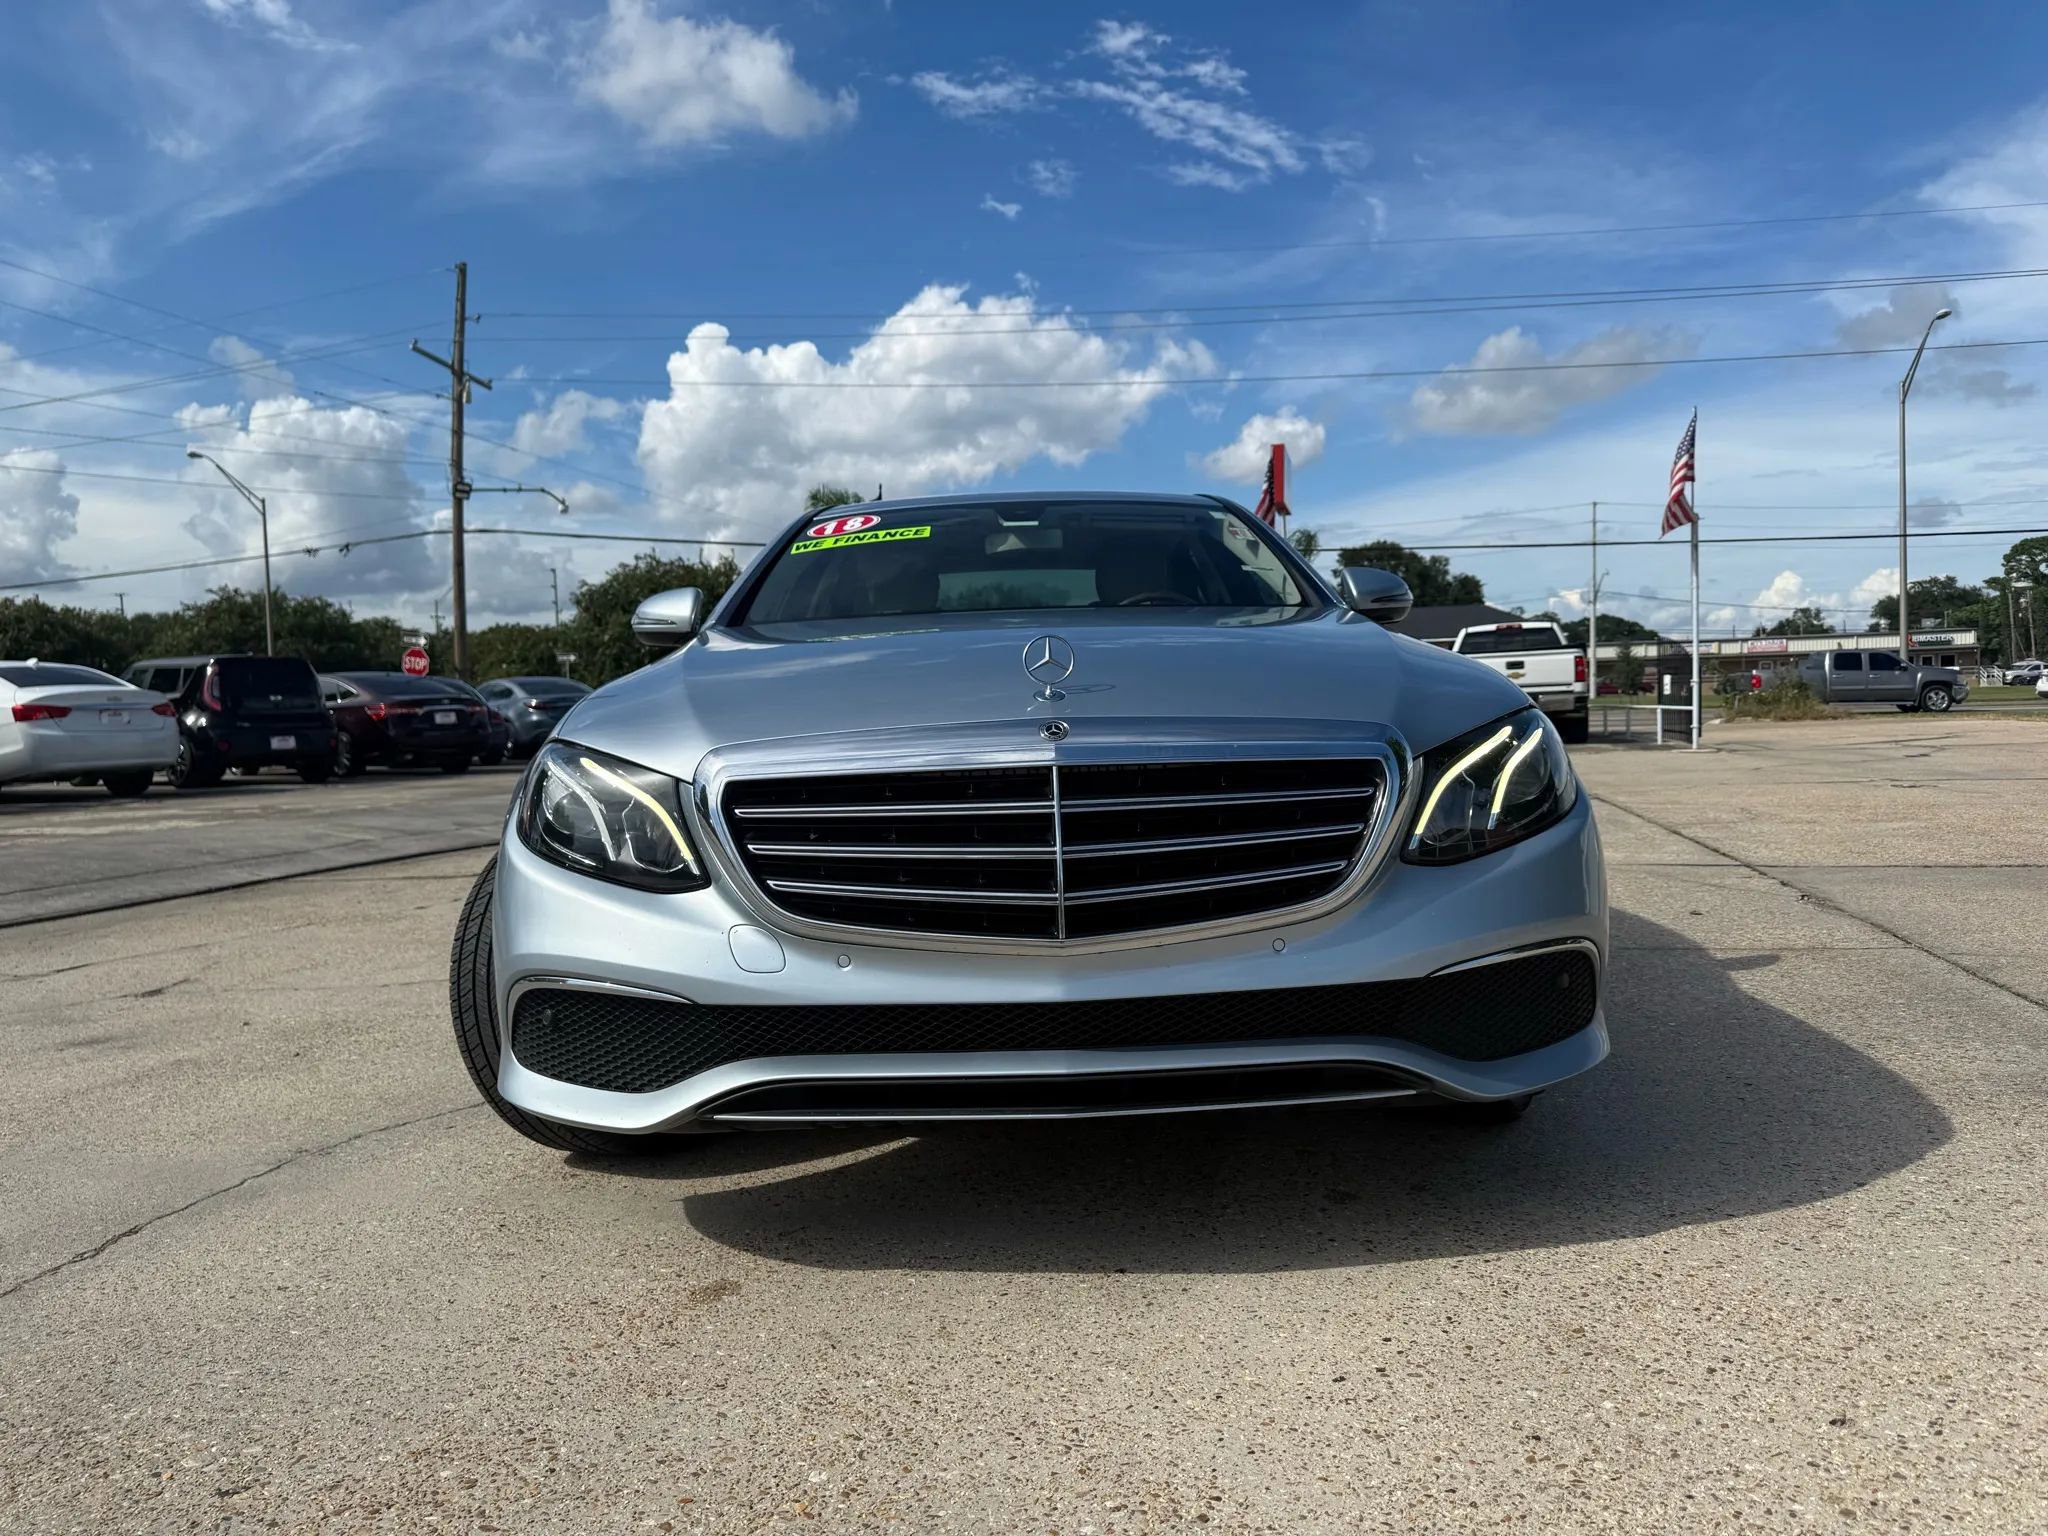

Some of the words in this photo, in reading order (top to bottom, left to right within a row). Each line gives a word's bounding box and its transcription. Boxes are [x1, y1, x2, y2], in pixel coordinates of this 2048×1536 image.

[823, 517, 865, 535] 18
[795, 540, 825, 551] WE
[832, 528, 928, 545] FINANCE
[404, 656, 428, 670] STOP
